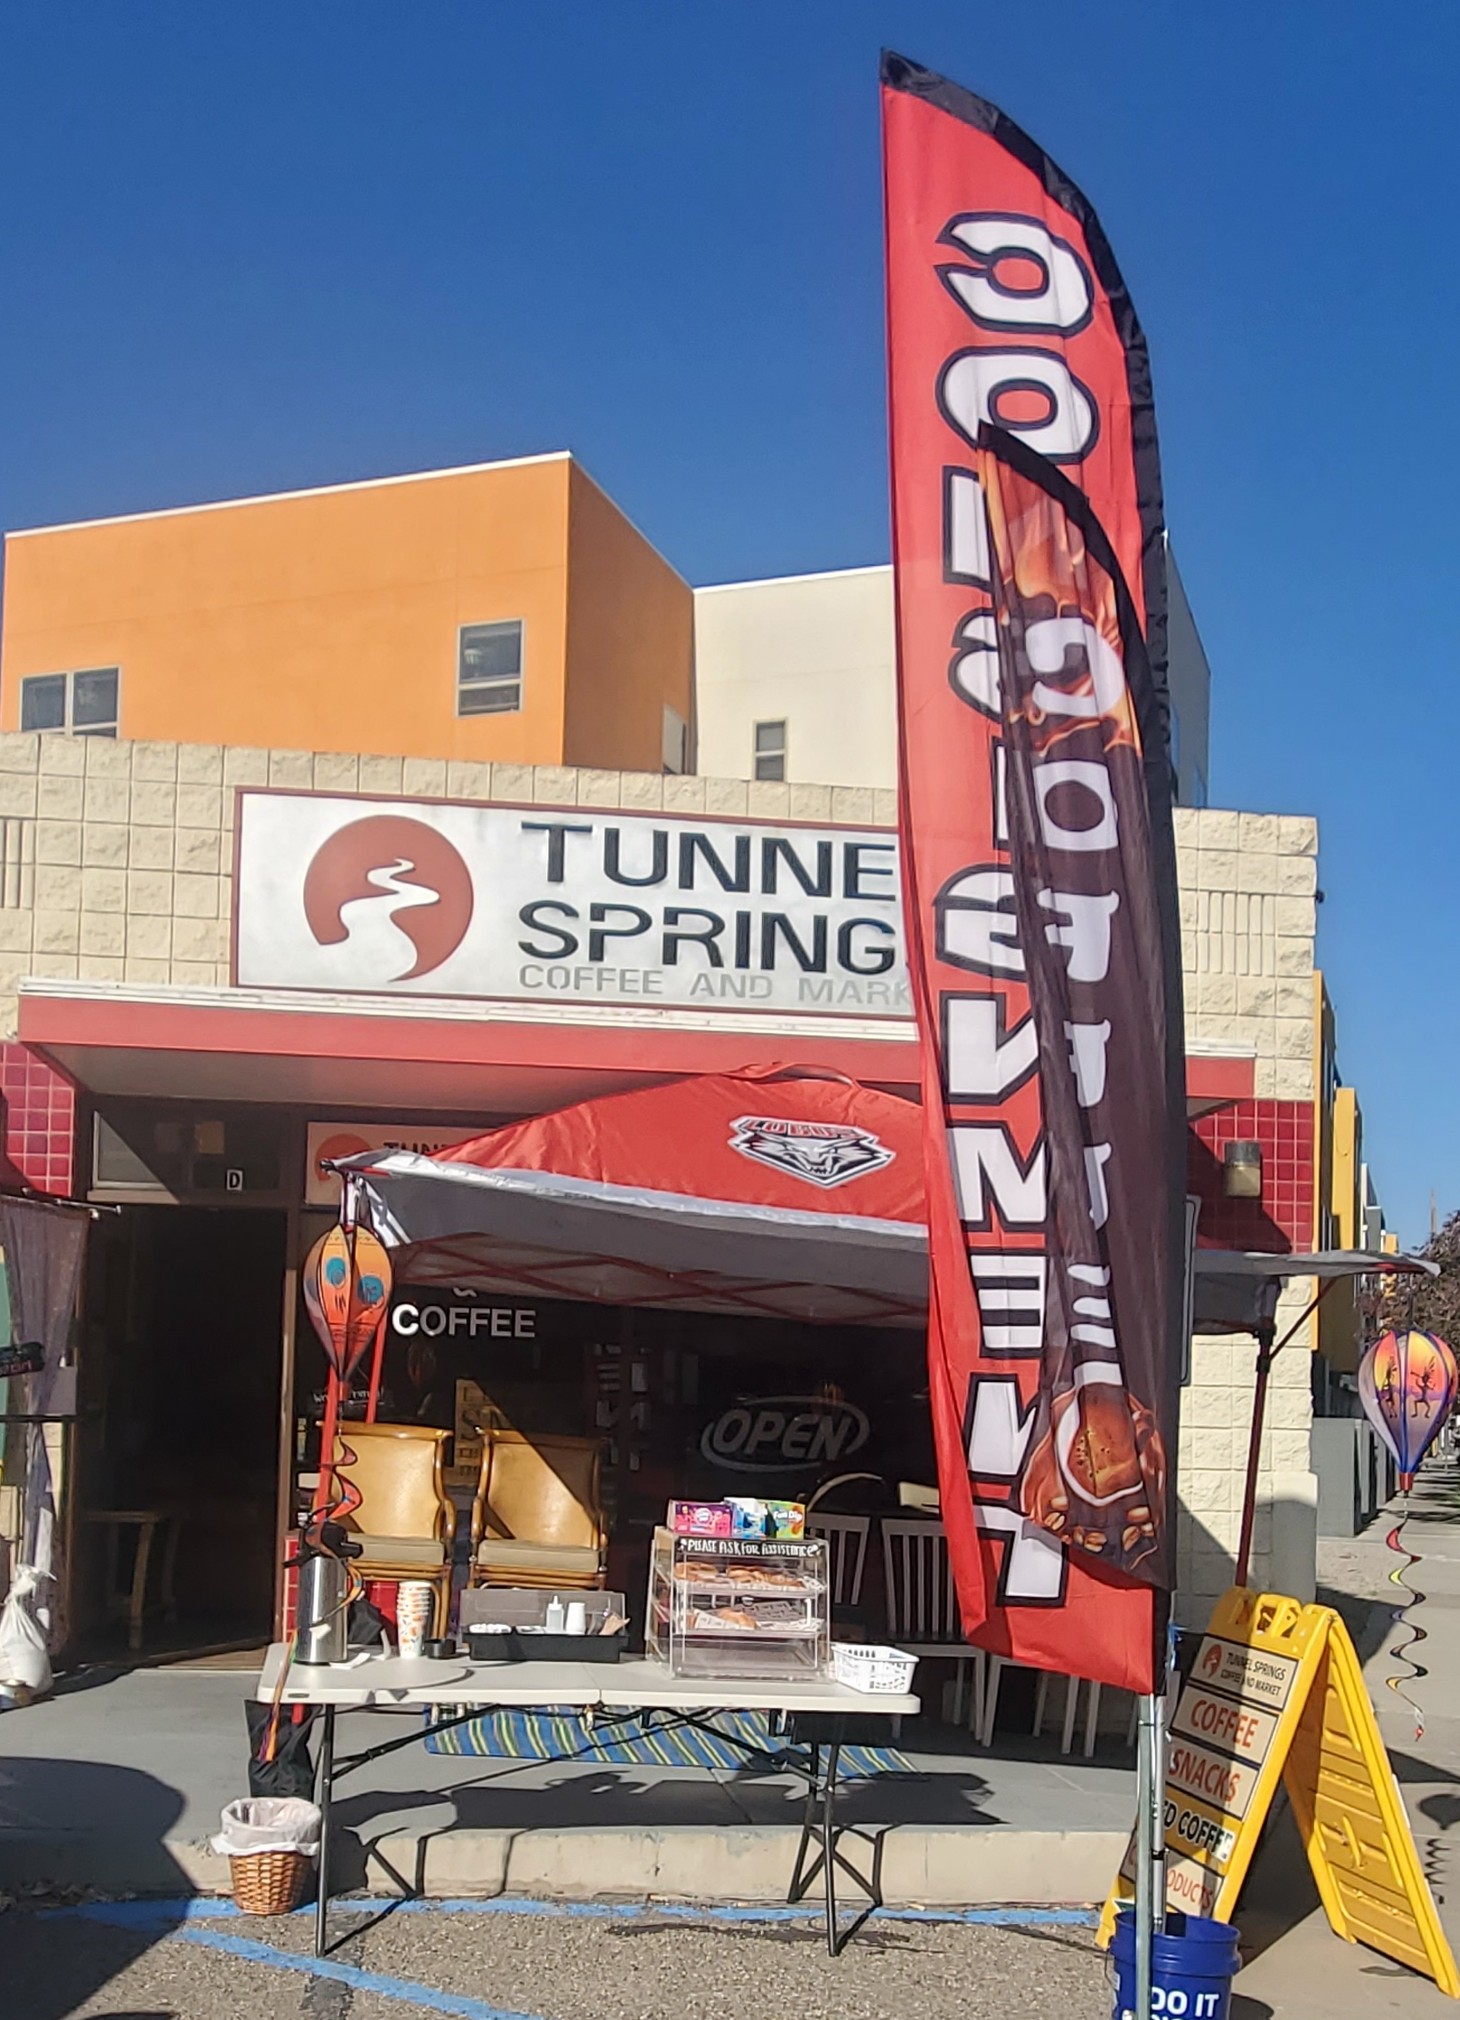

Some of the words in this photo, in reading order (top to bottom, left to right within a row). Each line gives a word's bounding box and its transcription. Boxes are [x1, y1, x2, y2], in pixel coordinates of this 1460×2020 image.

[520, 820, 897, 902] TUNNE
[517, 899, 899, 975] SPRING
[518, 964, 663, 995] COFFEE
[689, 972, 773, 999] AND
[799, 977, 908, 1007] MARK
[744, 1119, 863, 1140] LOBOS
[228, 1170, 241, 1190] D
[391, 1303, 537, 1338] COFFEE
[712, 1408, 851, 1461] OPEN
[687, 1539, 717, 1553] PLEASE
[719, 1541, 741, 1556] ASK
[741, 1541, 761, 1555] FOR
[1226, 1651, 1252, 1671] TUNNEL
[1253, 1660, 1287, 1681] SPRINGS
[1255, 1680, 1283, 1696] MARKET
[1190, 1698, 1260, 1749] COFFEE
[1168, 1748, 1241, 1802] SNACKS
[1166, 1868, 1213, 1909] ODUCTS
[1150, 1986, 1188, 2015] DO
[1195, 1993, 1220, 2017] IT
